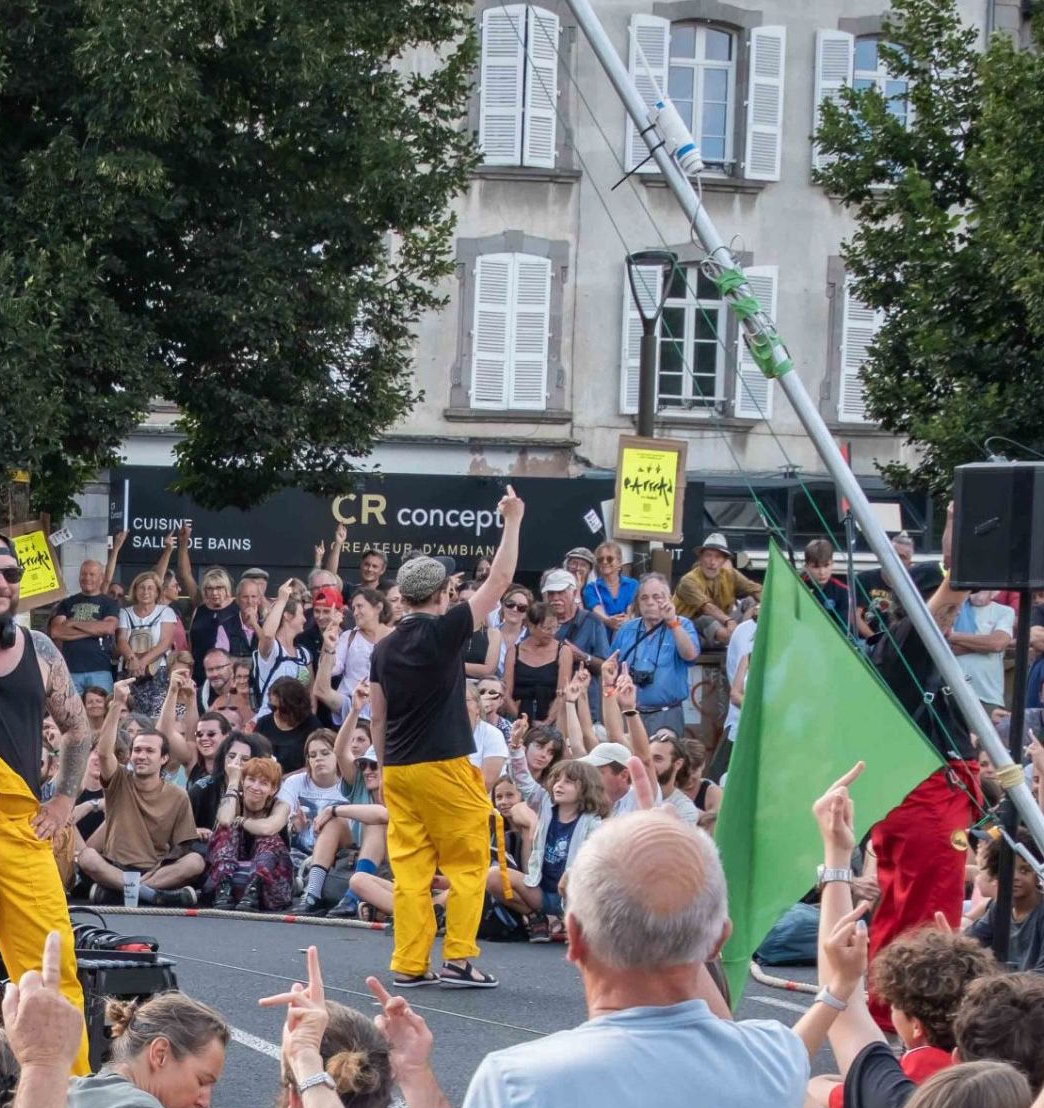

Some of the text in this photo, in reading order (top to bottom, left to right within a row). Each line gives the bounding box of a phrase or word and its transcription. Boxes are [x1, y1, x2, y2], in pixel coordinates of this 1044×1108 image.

[331, 493, 504, 536] CR concept
[133, 517, 193, 530] CUISINE
[132, 536, 178, 549] SALLE
[208, 538, 252, 551] BAINS
